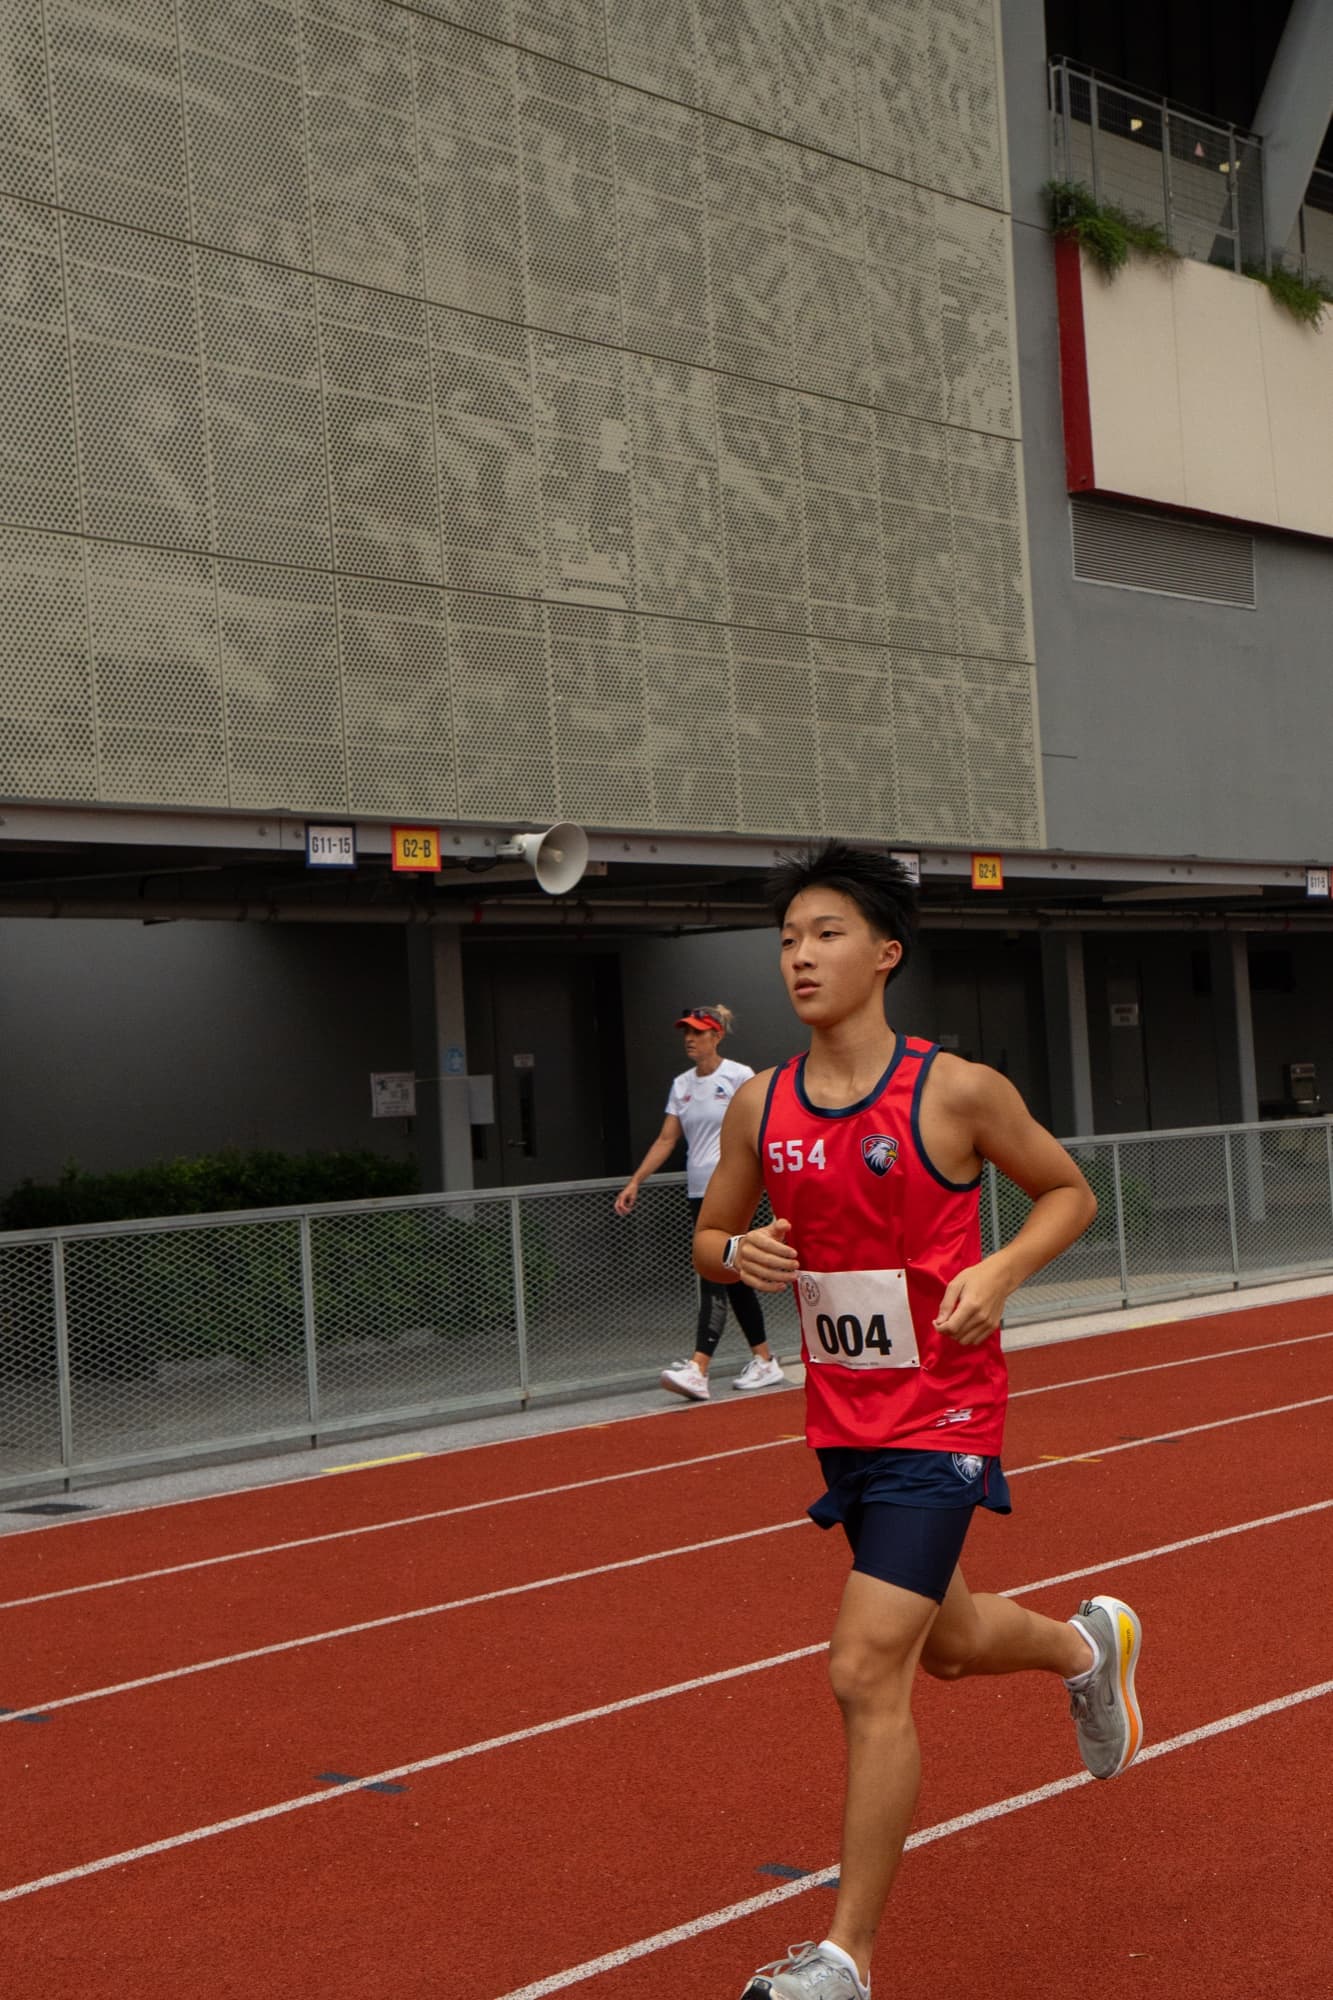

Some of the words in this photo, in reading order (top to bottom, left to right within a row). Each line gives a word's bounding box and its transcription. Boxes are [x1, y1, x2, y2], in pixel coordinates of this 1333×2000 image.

[311, 836, 351, 854] G11-15
[402, 838, 432, 858] G2-B
[978, 863, 997, 879] G2-A
[768, 1139, 827, 1174] 554
[816, 1314, 892, 1357] 004
